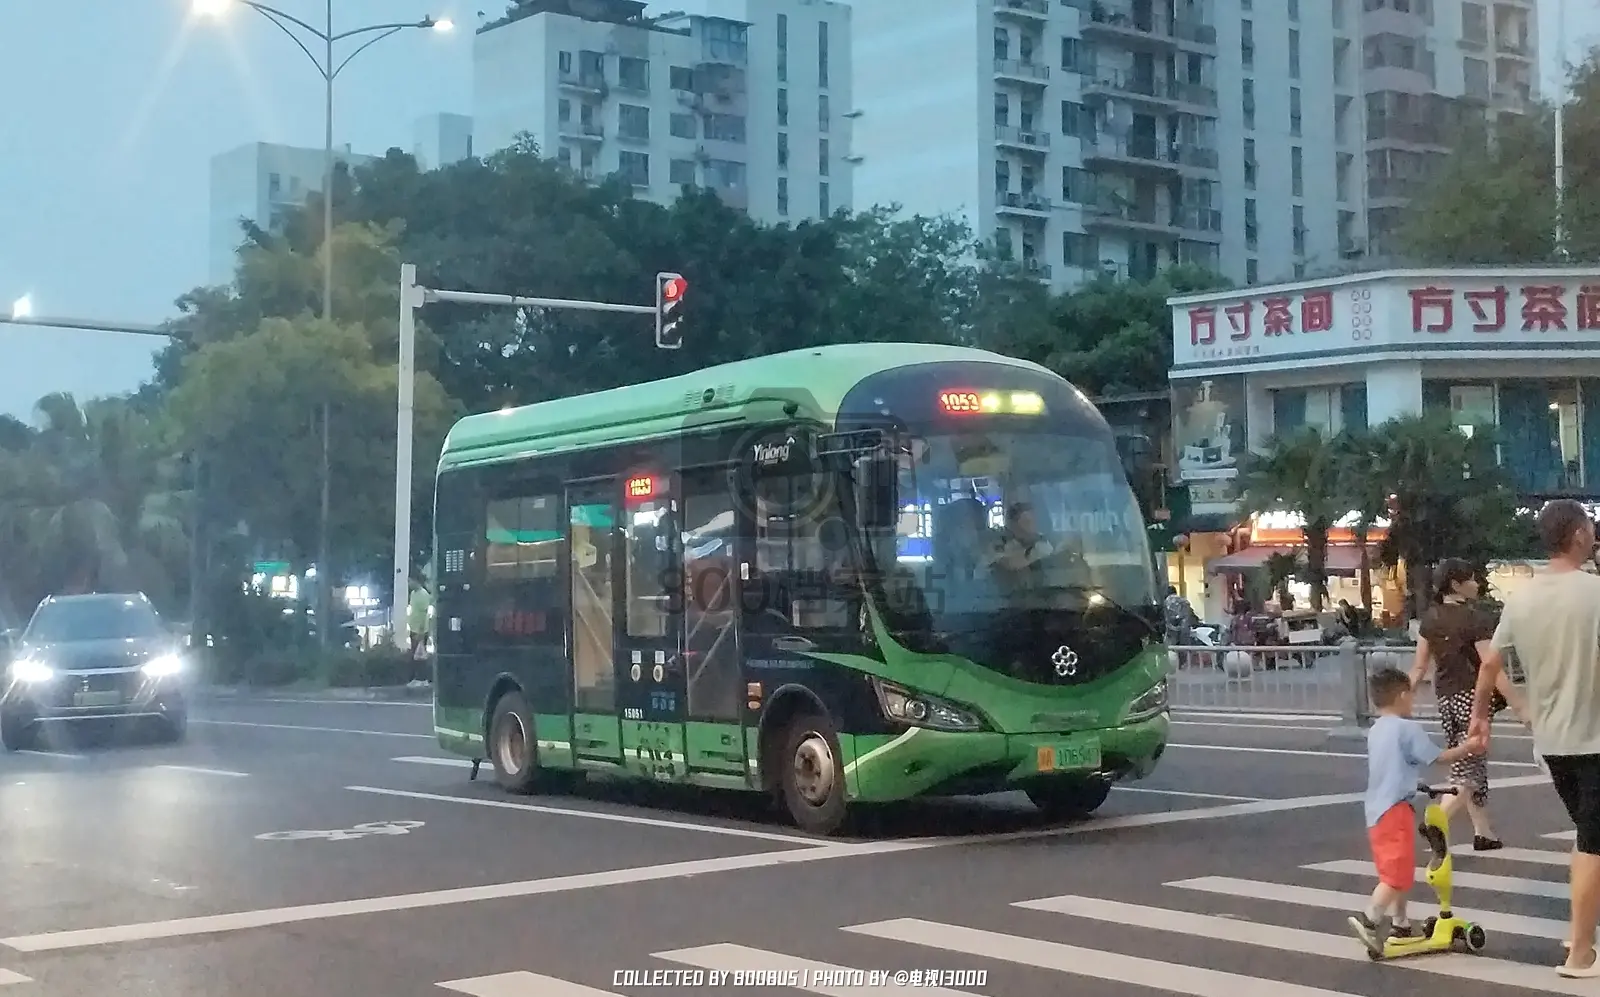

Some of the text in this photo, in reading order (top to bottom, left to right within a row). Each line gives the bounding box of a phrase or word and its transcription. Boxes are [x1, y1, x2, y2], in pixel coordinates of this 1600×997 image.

[1188, 292, 1333, 346] 方寸茶间
[940, 393, 980, 411] 1053
[753, 443, 790, 462] Yinlong
[624, 708, 644, 719] 15051
